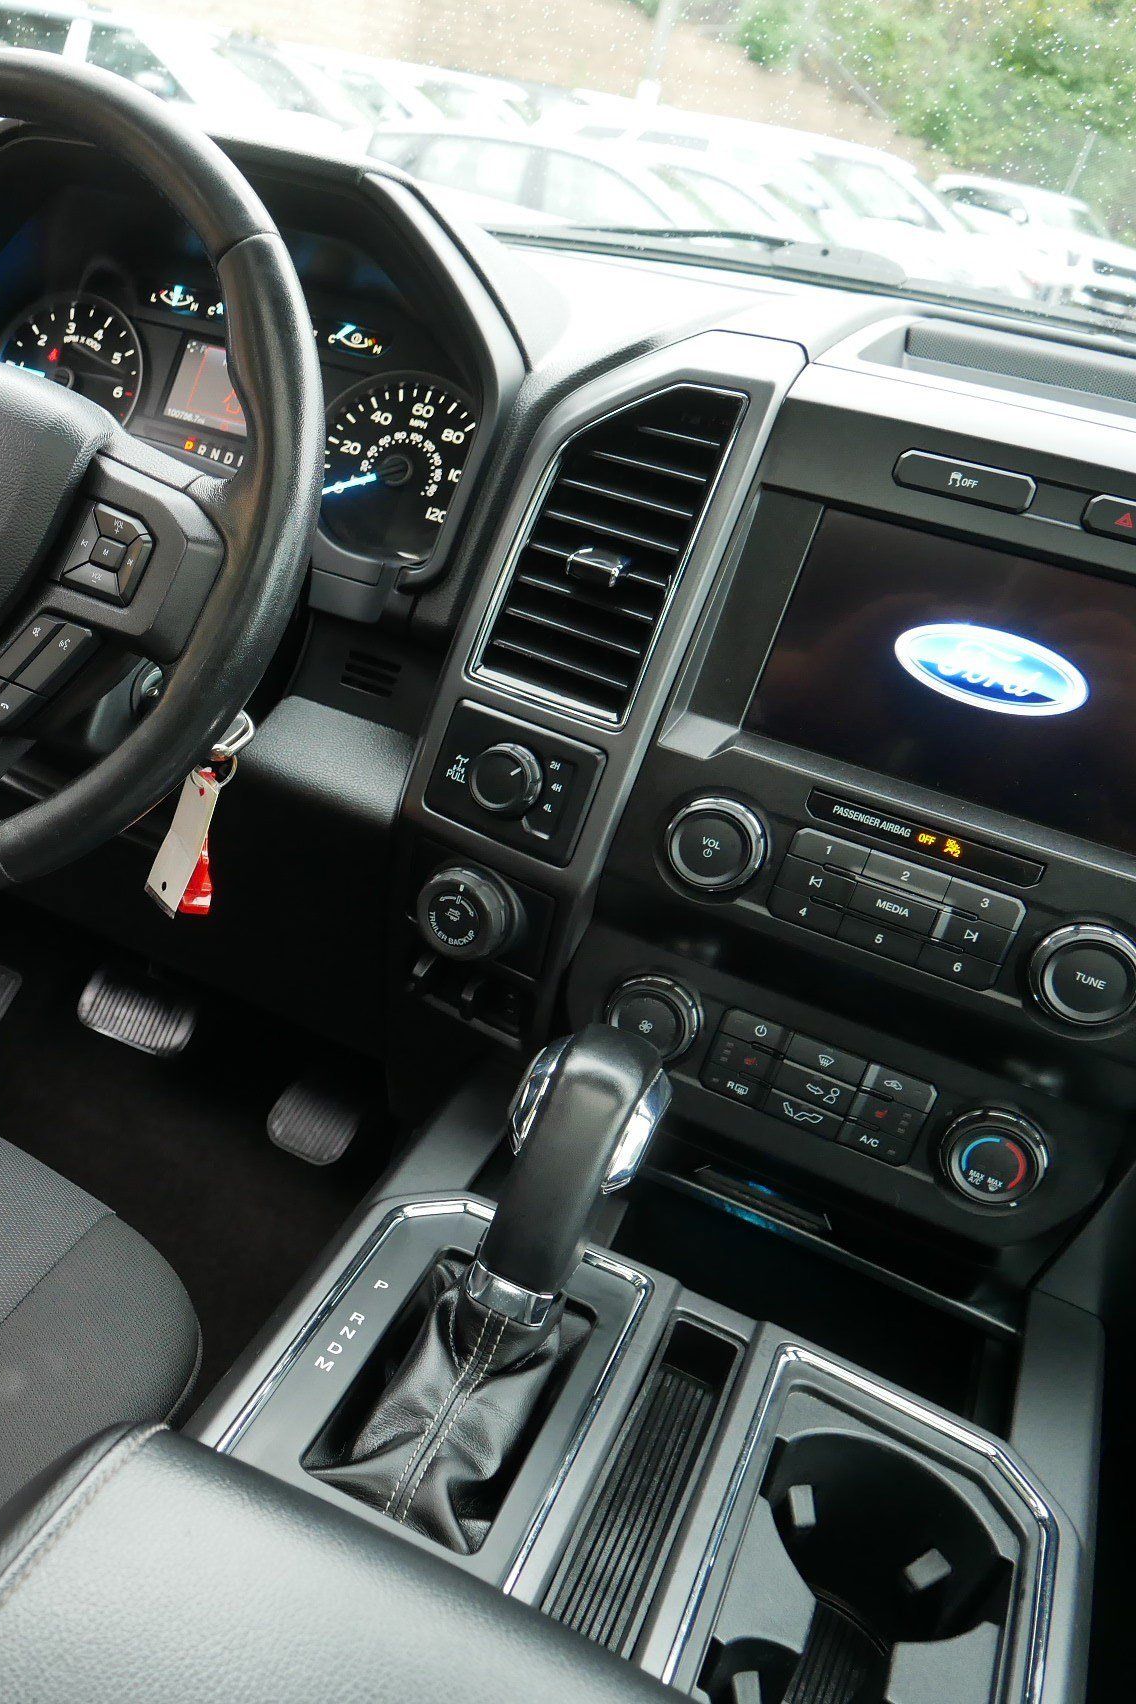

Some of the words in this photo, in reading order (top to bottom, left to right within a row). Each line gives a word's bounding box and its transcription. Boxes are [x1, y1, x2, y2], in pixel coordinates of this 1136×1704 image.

[66, 321, 76, 334] 3
[37, 334, 48, 347] 2
[94, 329, 104, 341] 4
[111, 352, 122, 365] 5
[113, 386, 124, 398] 6
[412, 402, 434, 418] 60
[370, 410, 392, 426] 40
[409, 418, 428, 429] MPH
[441, 428, 464, 444] 80
[340, 440, 362, 456] 20
[448, 468, 462, 482] 10
[961, 477, 979, 488] OFF
[936, 640, 1044, 697] Ford
[550, 760, 562, 771] 2H
[446, 768, 466, 784] PULL
[550, 782, 562, 792] 4H
[542, 804, 552, 813] 4L
[832, 805, 881, 830] PASSENGER
[879, 821, 912, 838] AIRBAG
[918, 833, 936, 846] OFF
[702, 836, 720, 850] VOL
[826, 845, 832, 855] 1
[900, 870, 910, 882] 2
[876, 898, 910, 918] MEDIA
[980, 898, 990, 908] 3
[798, 906, 808, 917] 4
[428, 911, 448, 942] TRAILER
[448, 930, 475, 946] BACKUP
[874, 934, 884, 944] 5
[952, 962, 963, 972] 6
[1075, 971, 1107, 990] TUNE
[859, 1134, 880, 1148] A/C
[374, 1280, 389, 1290] P
[349, 1312, 365, 1326] R
[339, 1326, 357, 1340] N
[326, 1342, 342, 1354] D
[314, 1356, 335, 1372] M
